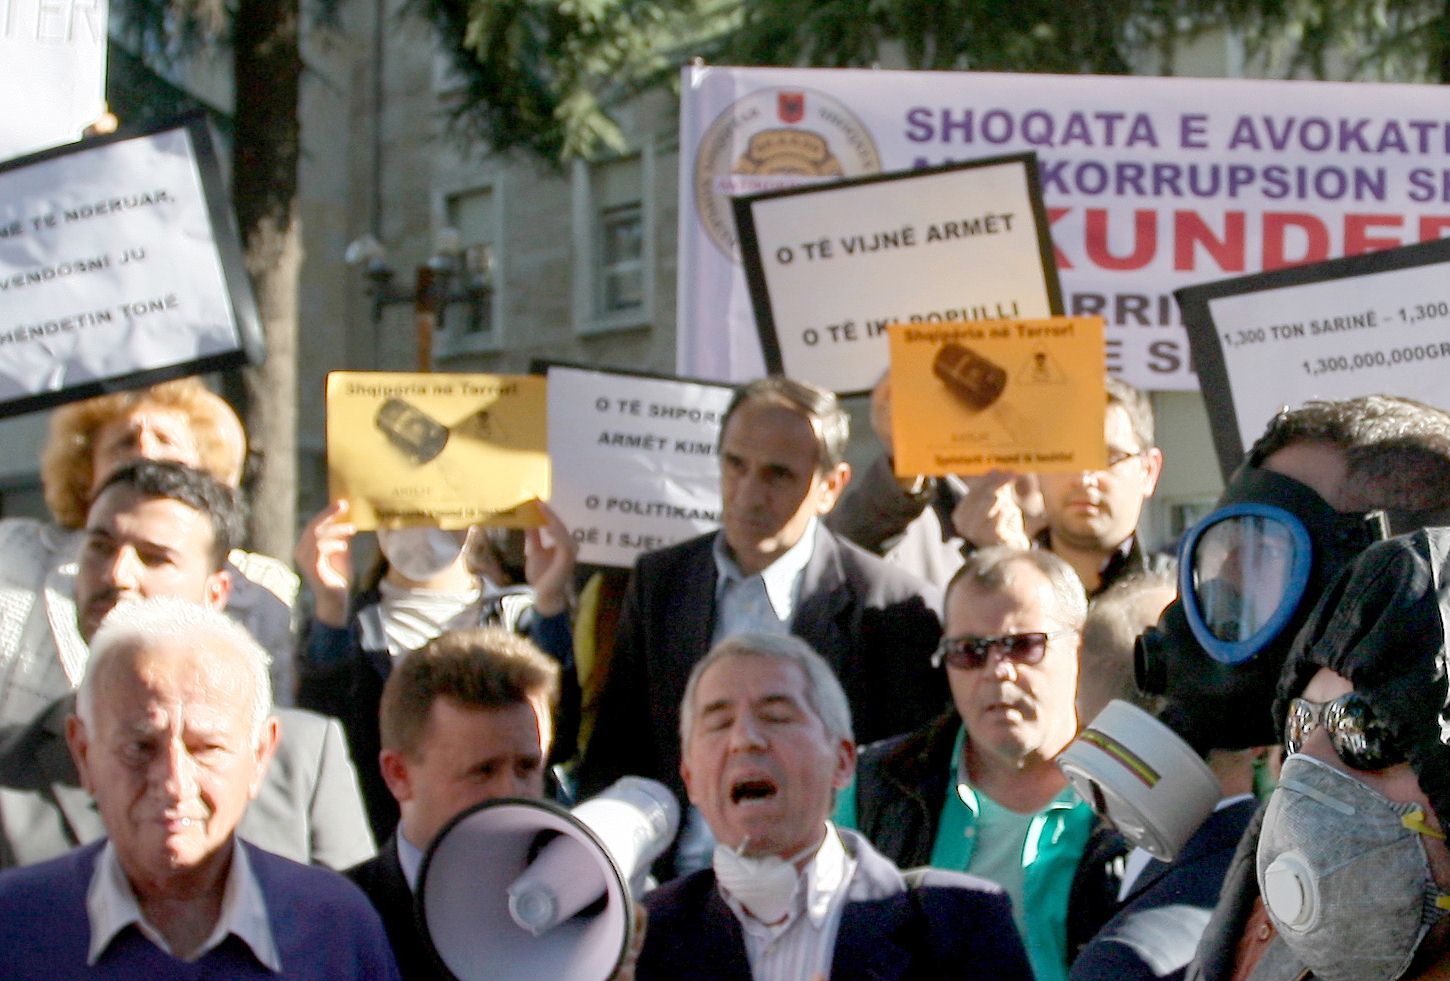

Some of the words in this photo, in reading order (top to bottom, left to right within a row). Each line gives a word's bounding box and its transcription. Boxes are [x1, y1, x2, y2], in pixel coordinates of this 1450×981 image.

[905, 107, 1159, 148] SHOQATA
[1180, 114, 1208, 148] E
[776, 247, 794, 265] O
[802, 238, 833, 260] TË
[841, 225, 916, 255] VIJNË
[926, 212, 1016, 243] ARMËT
[119, 247, 145, 265] JU
[803, 329, 819, 347] O
[827, 320, 857, 343] TË
[1224, 326, 1266, 349] 1,300
[1270, 322, 1306, 341] TON
[1310, 310, 1378, 336] SARINË
[595, 397, 609, 412] O
[617, 398, 641, 416] TË
[597, 431, 668, 451] ARMËT
[585, 495, 599, 510] O
[607, 498, 721, 522] POLITIKAN
